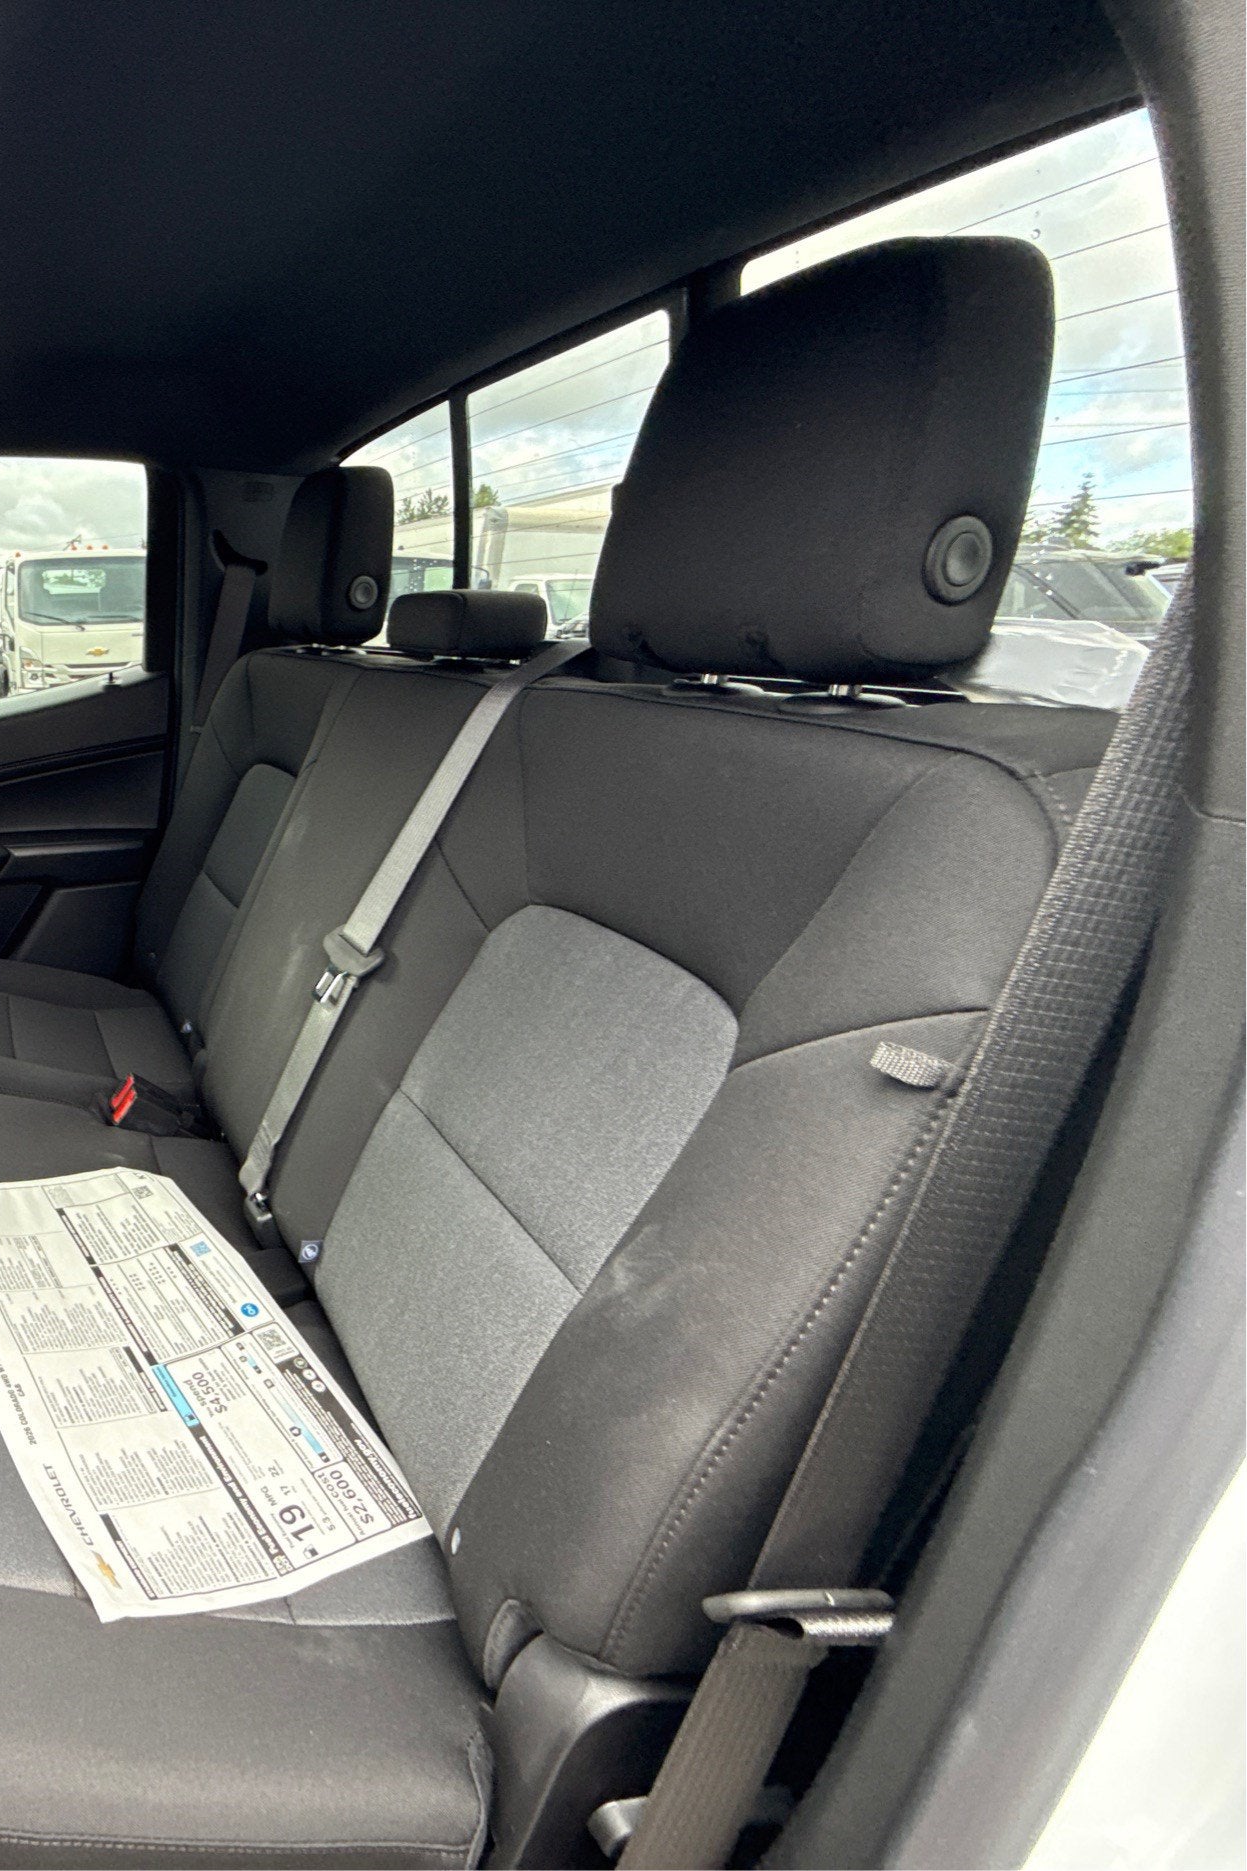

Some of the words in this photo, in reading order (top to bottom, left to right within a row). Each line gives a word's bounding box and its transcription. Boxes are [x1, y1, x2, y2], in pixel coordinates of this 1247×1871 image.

[182, 1379, 209, 1406] spend
[190, 1371, 229, 1413] $4,500
[6, 1389, 29, 1425] COLORADO
[23, 1426, 37, 1445] 2026
[198, 1435, 233, 1482] Environment
[266, 1466, 280, 1477] 22
[227, 1481, 242, 1497] and
[279, 1485, 292, 1495] 17
[316, 1472, 340, 1498] cost
[353, 1438, 418, 1518] fueleconomy.gov
[42, 1462, 94, 1546] CHEVROLET
[259, 1485, 278, 1506] MPG
[327, 1469, 376, 1524] $2,600
[237, 1497, 266, 1535] Economy
[274, 1503, 320, 1542] 19
[320, 1516, 336, 1530] 5.3
[259, 1535, 279, 1554] Fuel
